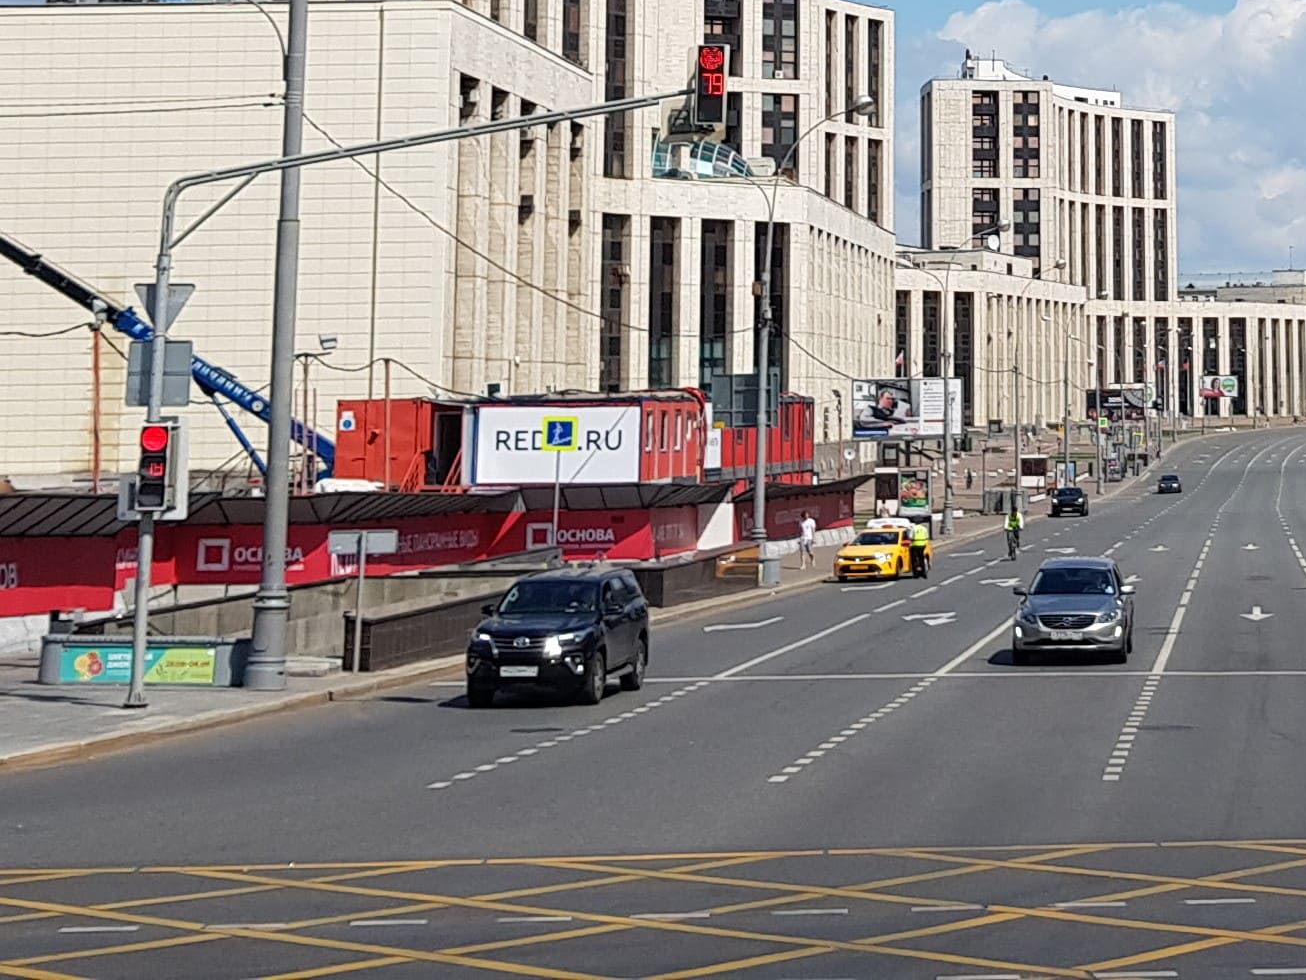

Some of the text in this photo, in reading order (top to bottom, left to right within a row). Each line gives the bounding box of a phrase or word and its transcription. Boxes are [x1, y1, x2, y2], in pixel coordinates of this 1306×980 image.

[702, 73, 723, 95] 79
[495, 429, 622, 451] RED.RU
[557, 528, 615, 542] ОСНОВА
[234, 546, 303, 562] ОСВА
